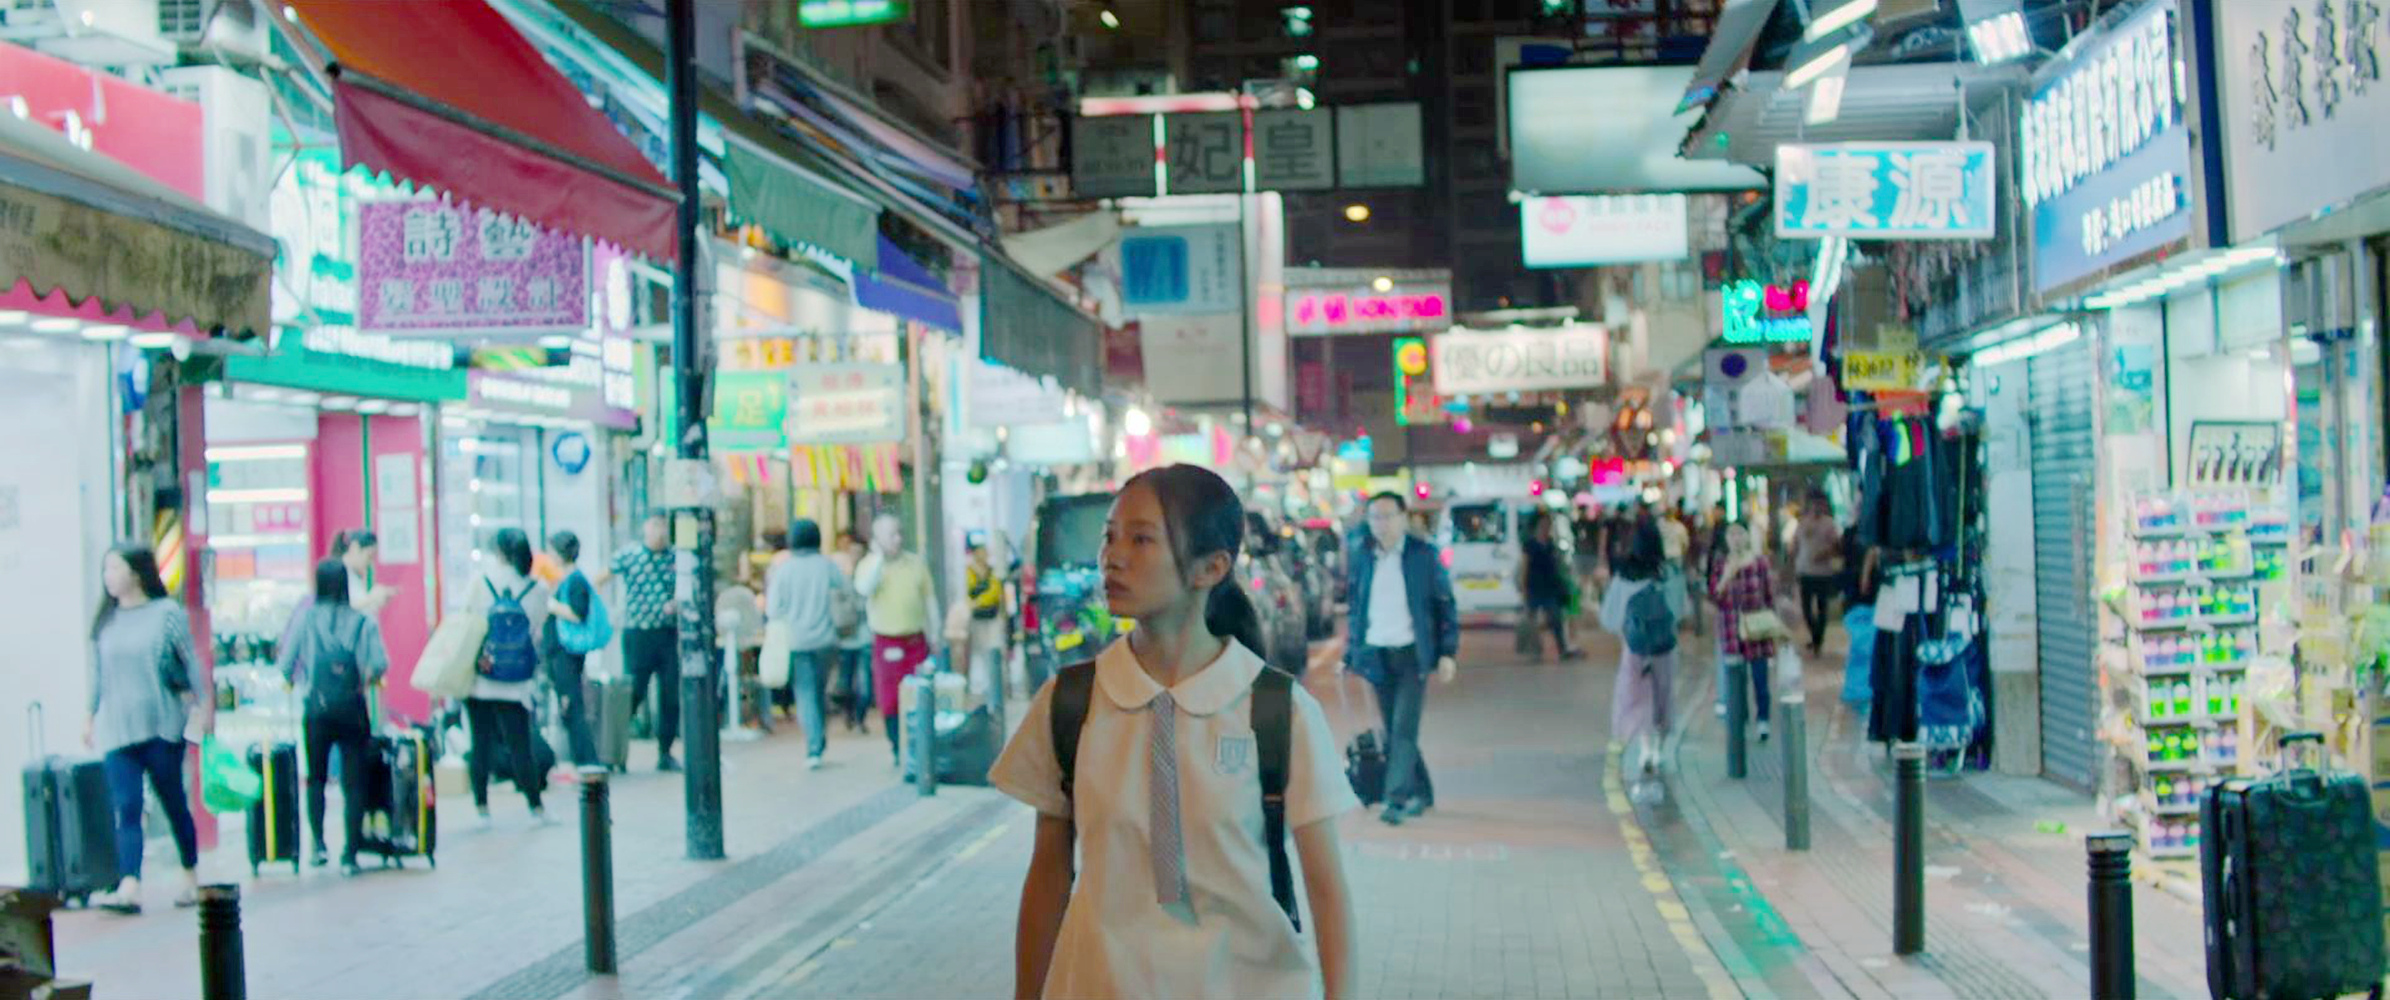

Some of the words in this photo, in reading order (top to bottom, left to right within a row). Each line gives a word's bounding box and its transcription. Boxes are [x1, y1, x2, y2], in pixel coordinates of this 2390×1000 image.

[1803, 150, 1970, 229] 康源
[404, 206, 537, 263] 詩藝
[1444, 336, 1599, 381] 優の良品
